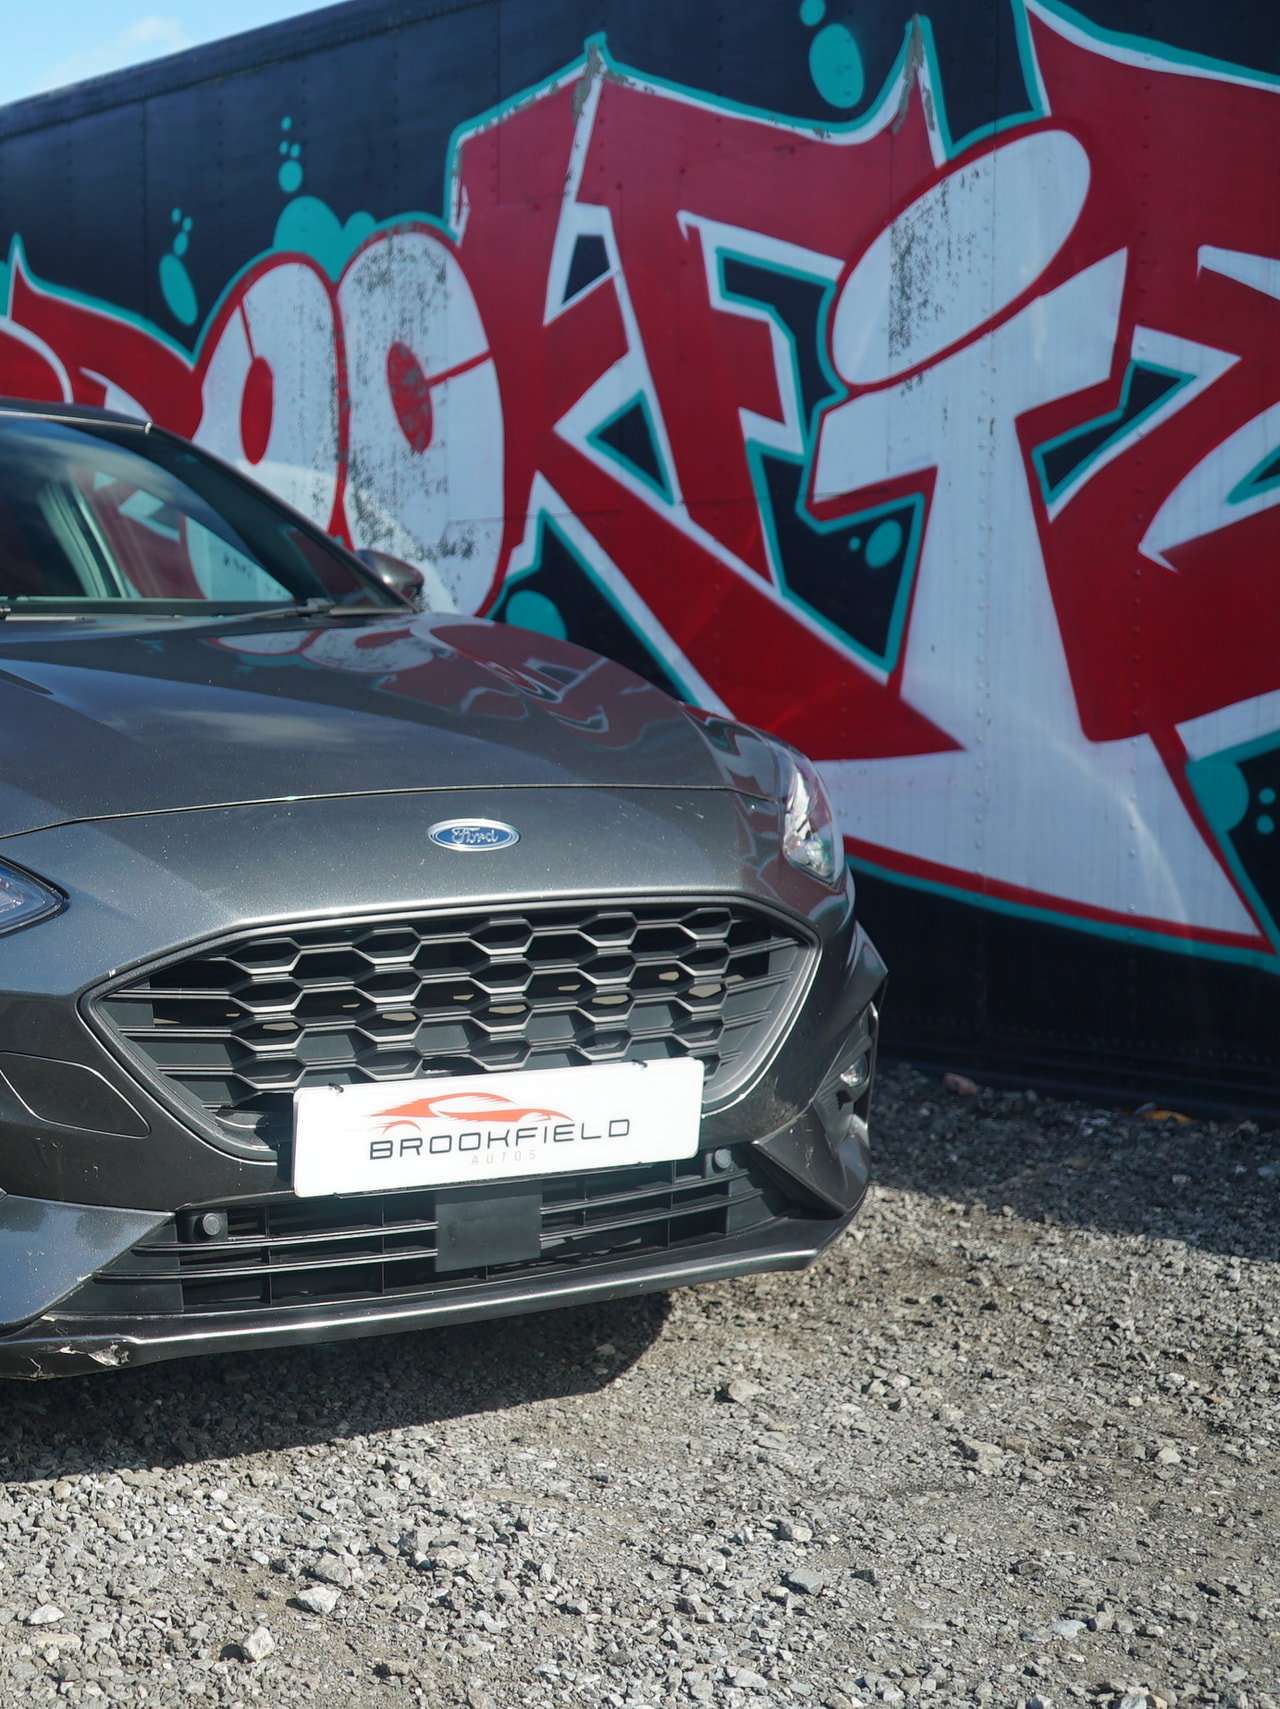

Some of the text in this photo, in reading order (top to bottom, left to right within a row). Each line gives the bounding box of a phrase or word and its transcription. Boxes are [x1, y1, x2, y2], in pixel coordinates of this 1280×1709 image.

[451, 827, 498, 844] Ford
[369, 1119, 631, 1160] BROOKFIELD
[471, 1149, 537, 1165] AUTOS
